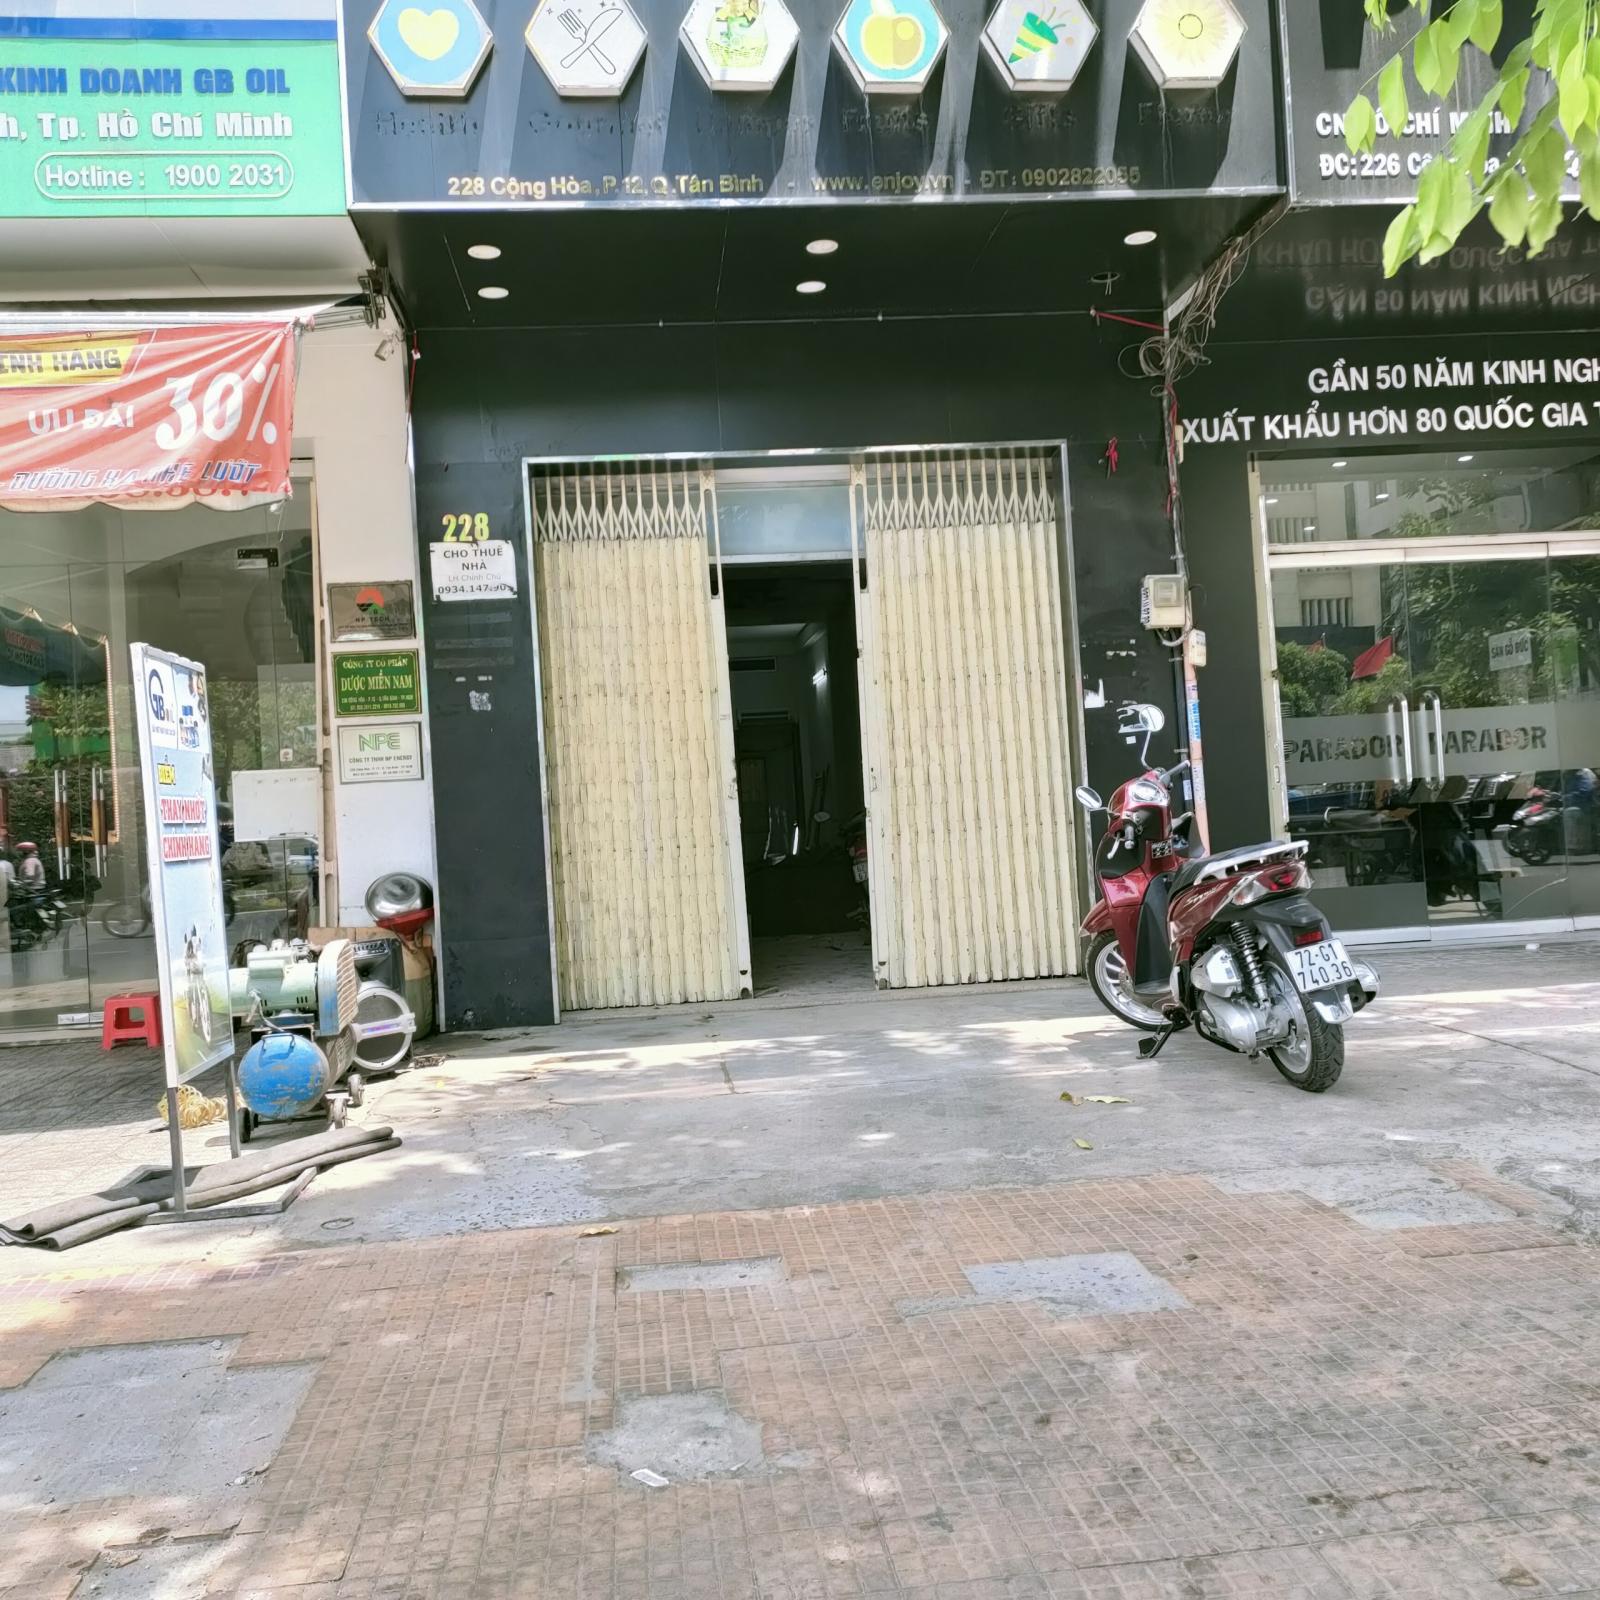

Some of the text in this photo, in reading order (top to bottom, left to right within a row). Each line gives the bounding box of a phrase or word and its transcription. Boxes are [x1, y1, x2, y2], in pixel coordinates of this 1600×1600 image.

[0, 67, 290, 94] KINH DOANH GB OIL
[37, 112, 86, 141] Tp.
[98, 107, 139, 138] Hồ
[151, 112, 203, 137] Chí
[216, 112, 292, 137] Minh
[165, 164, 220, 187] 1900
[229, 164, 285, 187] 2031
[447, 177, 486, 196] 228
[490, 176, 546, 200] Cộng
[719, 174, 764, 193] Bình
[1021, 166, 1141, 187] 0902822055
[1307, 357, 1370, 394] GẦN
[1375, 364, 1407, 390] 50
[1413, 356, 1475, 388] NĂM
[1483, 359, 1547, 386] KINH
[155, 363, 281, 451] 30%
[1182, 407, 1256, 444] XUẤT
[1263, 400, 1341, 441] KHẨU
[1348, 405, 1409, 437] HƠN
[1415, 407, 1448, 433] 80
[1454, 395, 1535, 431] QUỐC
[1541, 402, 1589, 428] GIA
[442, 512, 490, 542] 228
[443, 545, 503, 559] CHO THUÊ
[461, 559, 487, 571] NHÀ
[341, 675, 366, 694] DƯỢC
[393, 674, 413, 690] NAM
[358, 732, 400, 752] NPE
